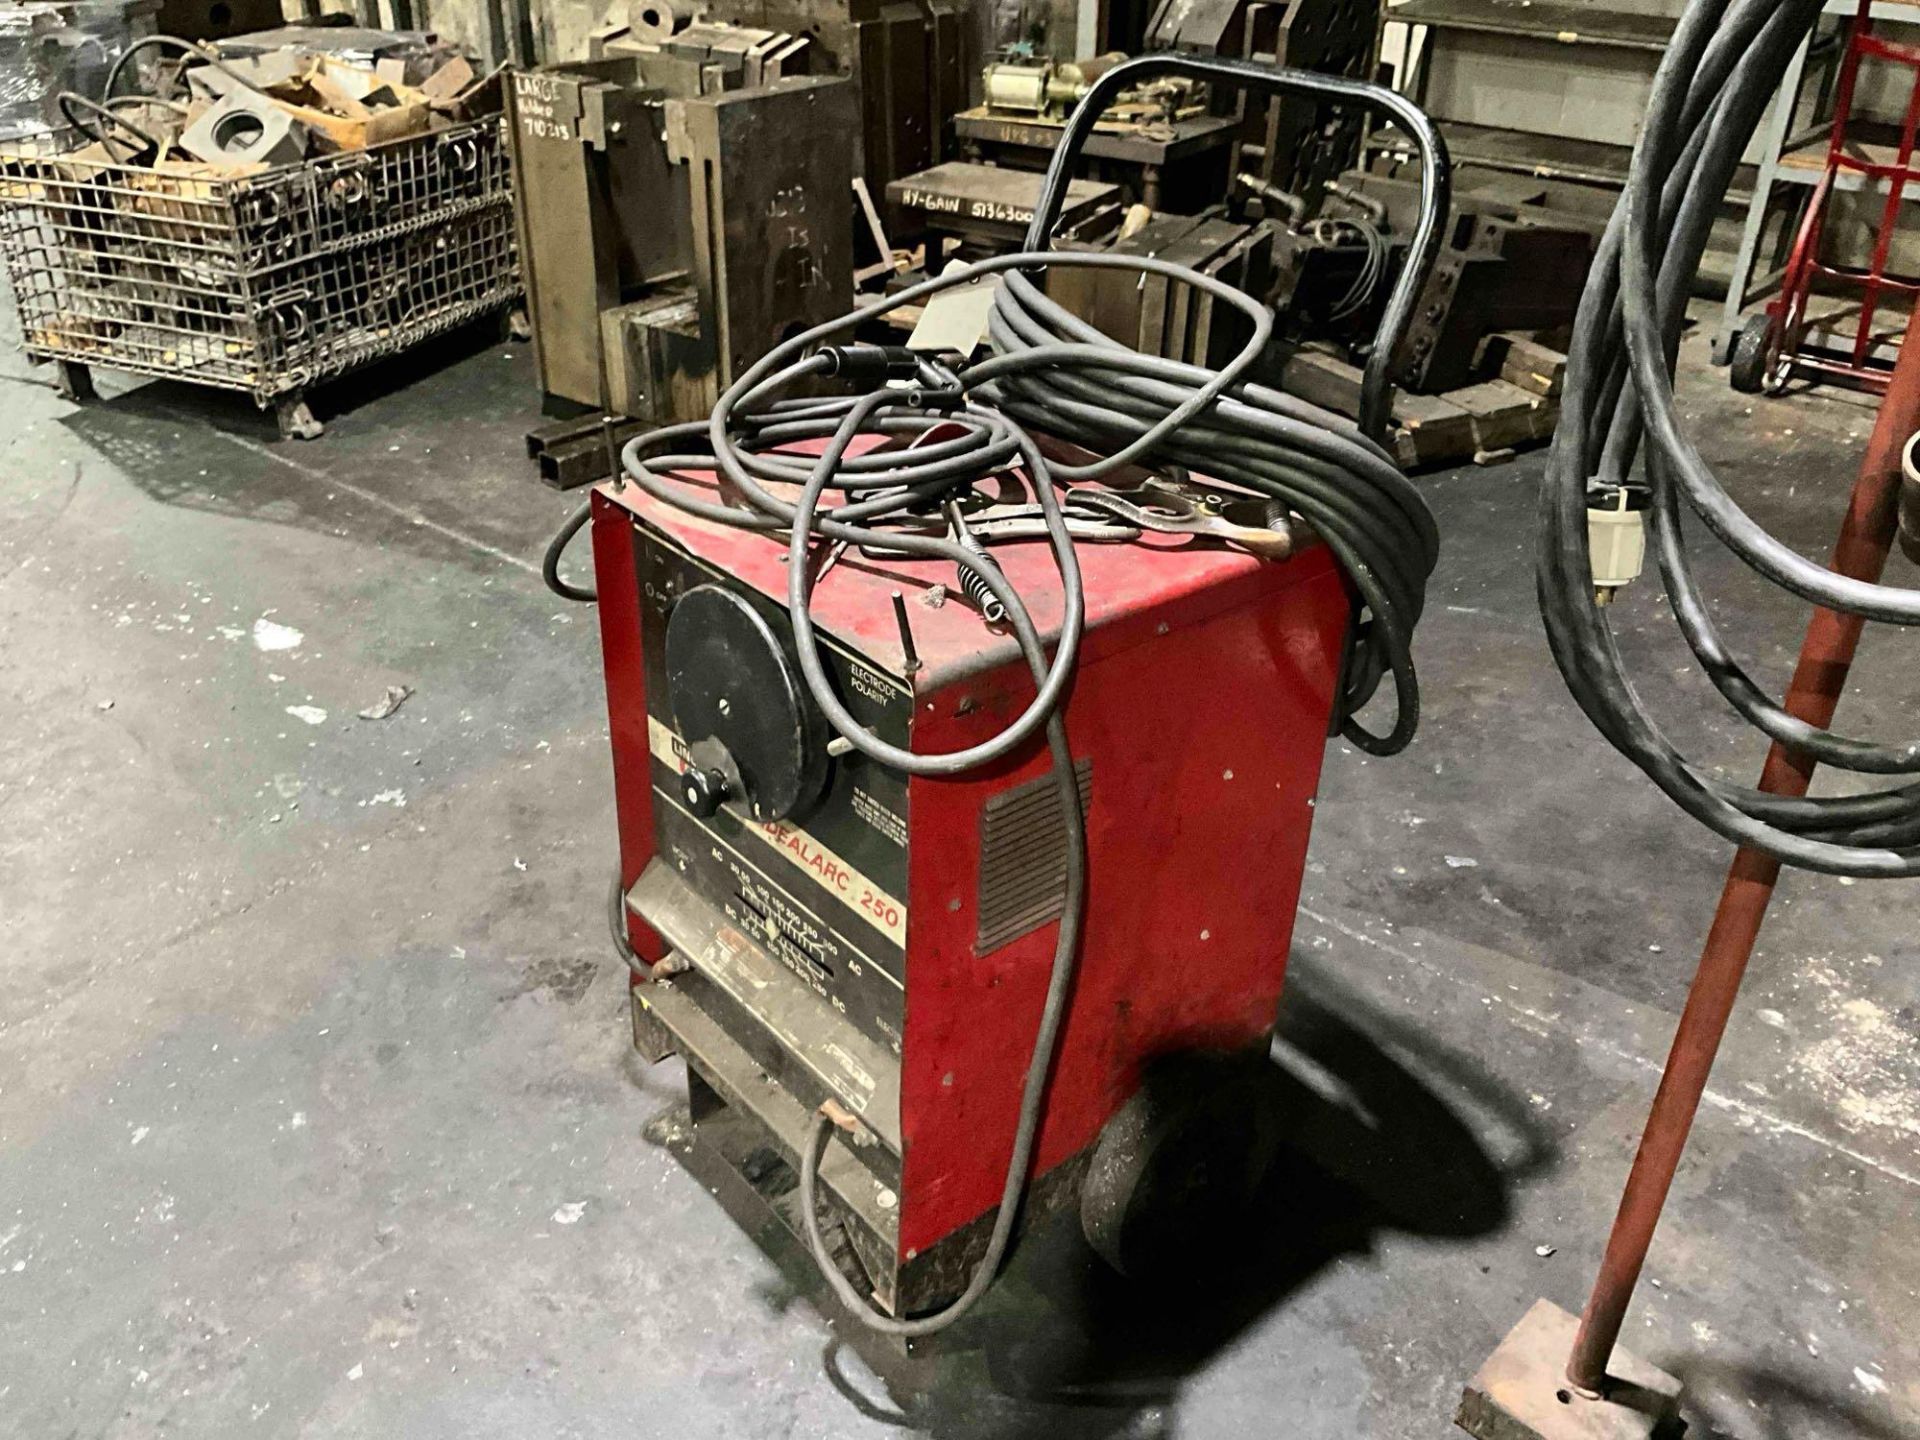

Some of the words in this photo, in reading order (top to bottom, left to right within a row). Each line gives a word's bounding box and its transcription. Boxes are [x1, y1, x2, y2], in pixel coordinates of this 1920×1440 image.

[851, 663, 897, 700] ELECTRODE
[851, 677, 888, 707] POLARITY
[861, 890, 899, 928] 250
